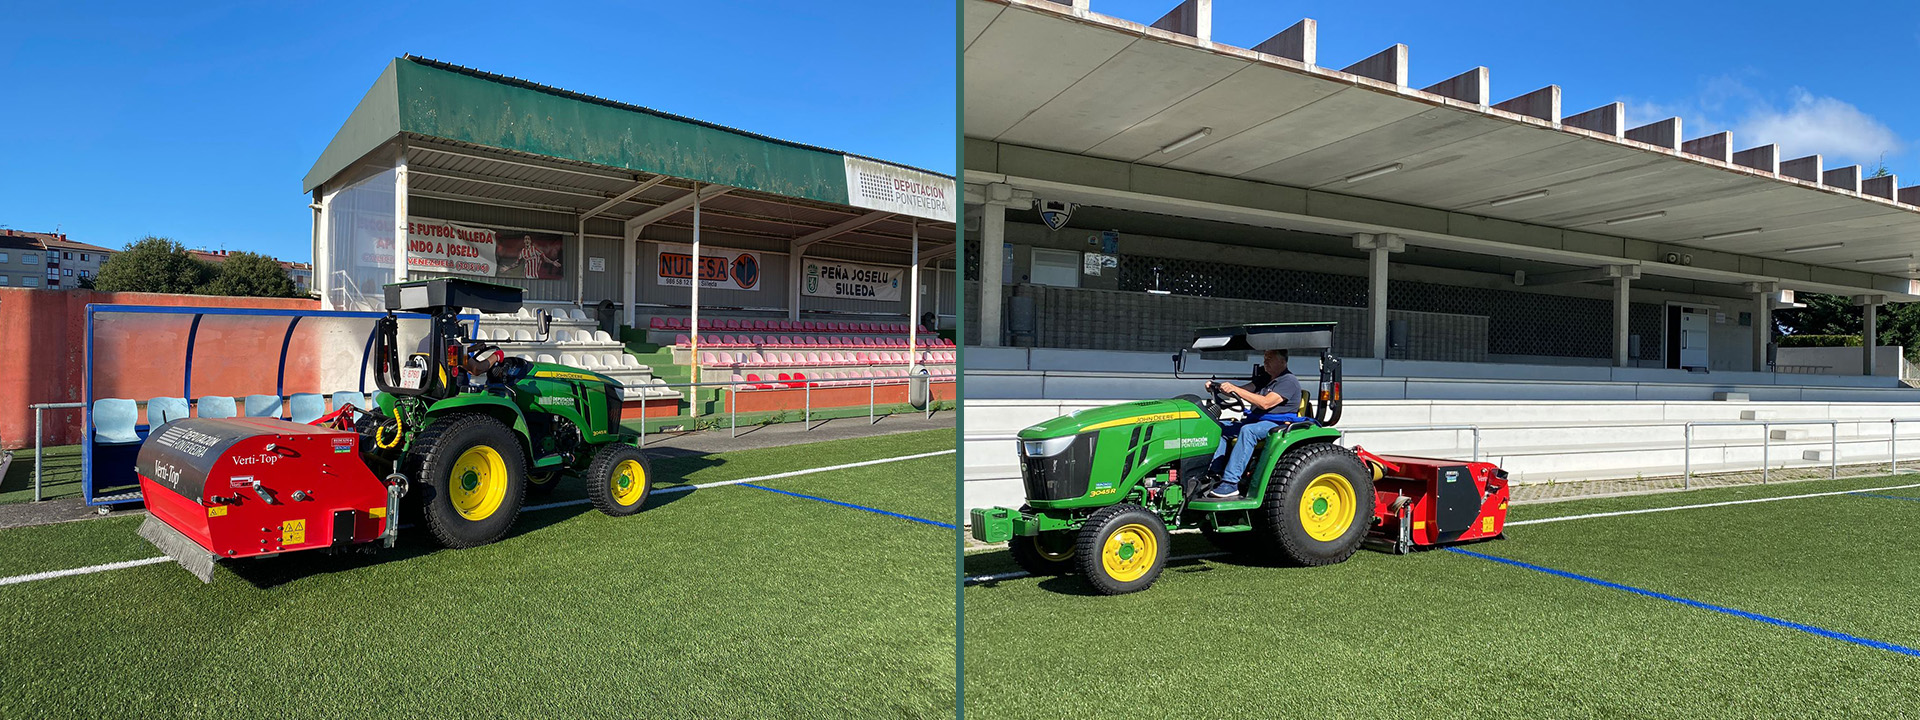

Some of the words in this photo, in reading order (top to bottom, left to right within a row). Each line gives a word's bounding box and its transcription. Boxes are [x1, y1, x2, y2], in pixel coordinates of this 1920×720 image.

[893, 178, 945, 200] DEPUTACIÓN
[895, 191, 948, 211] PONTEVEDRA
[417, 223, 455, 239] FUTBOL
[457, 229, 494, 244] SILLEDA
[436, 243, 444, 254] A
[447, 243, 479, 258] JOSELU
[661, 255, 727, 278] NUDESA
[821, 265, 849, 280] PEÑA
[851, 269, 889, 284] JOSELU
[835, 282, 876, 297] SILLEDA
[1090, 488, 1116, 498] 3045R
